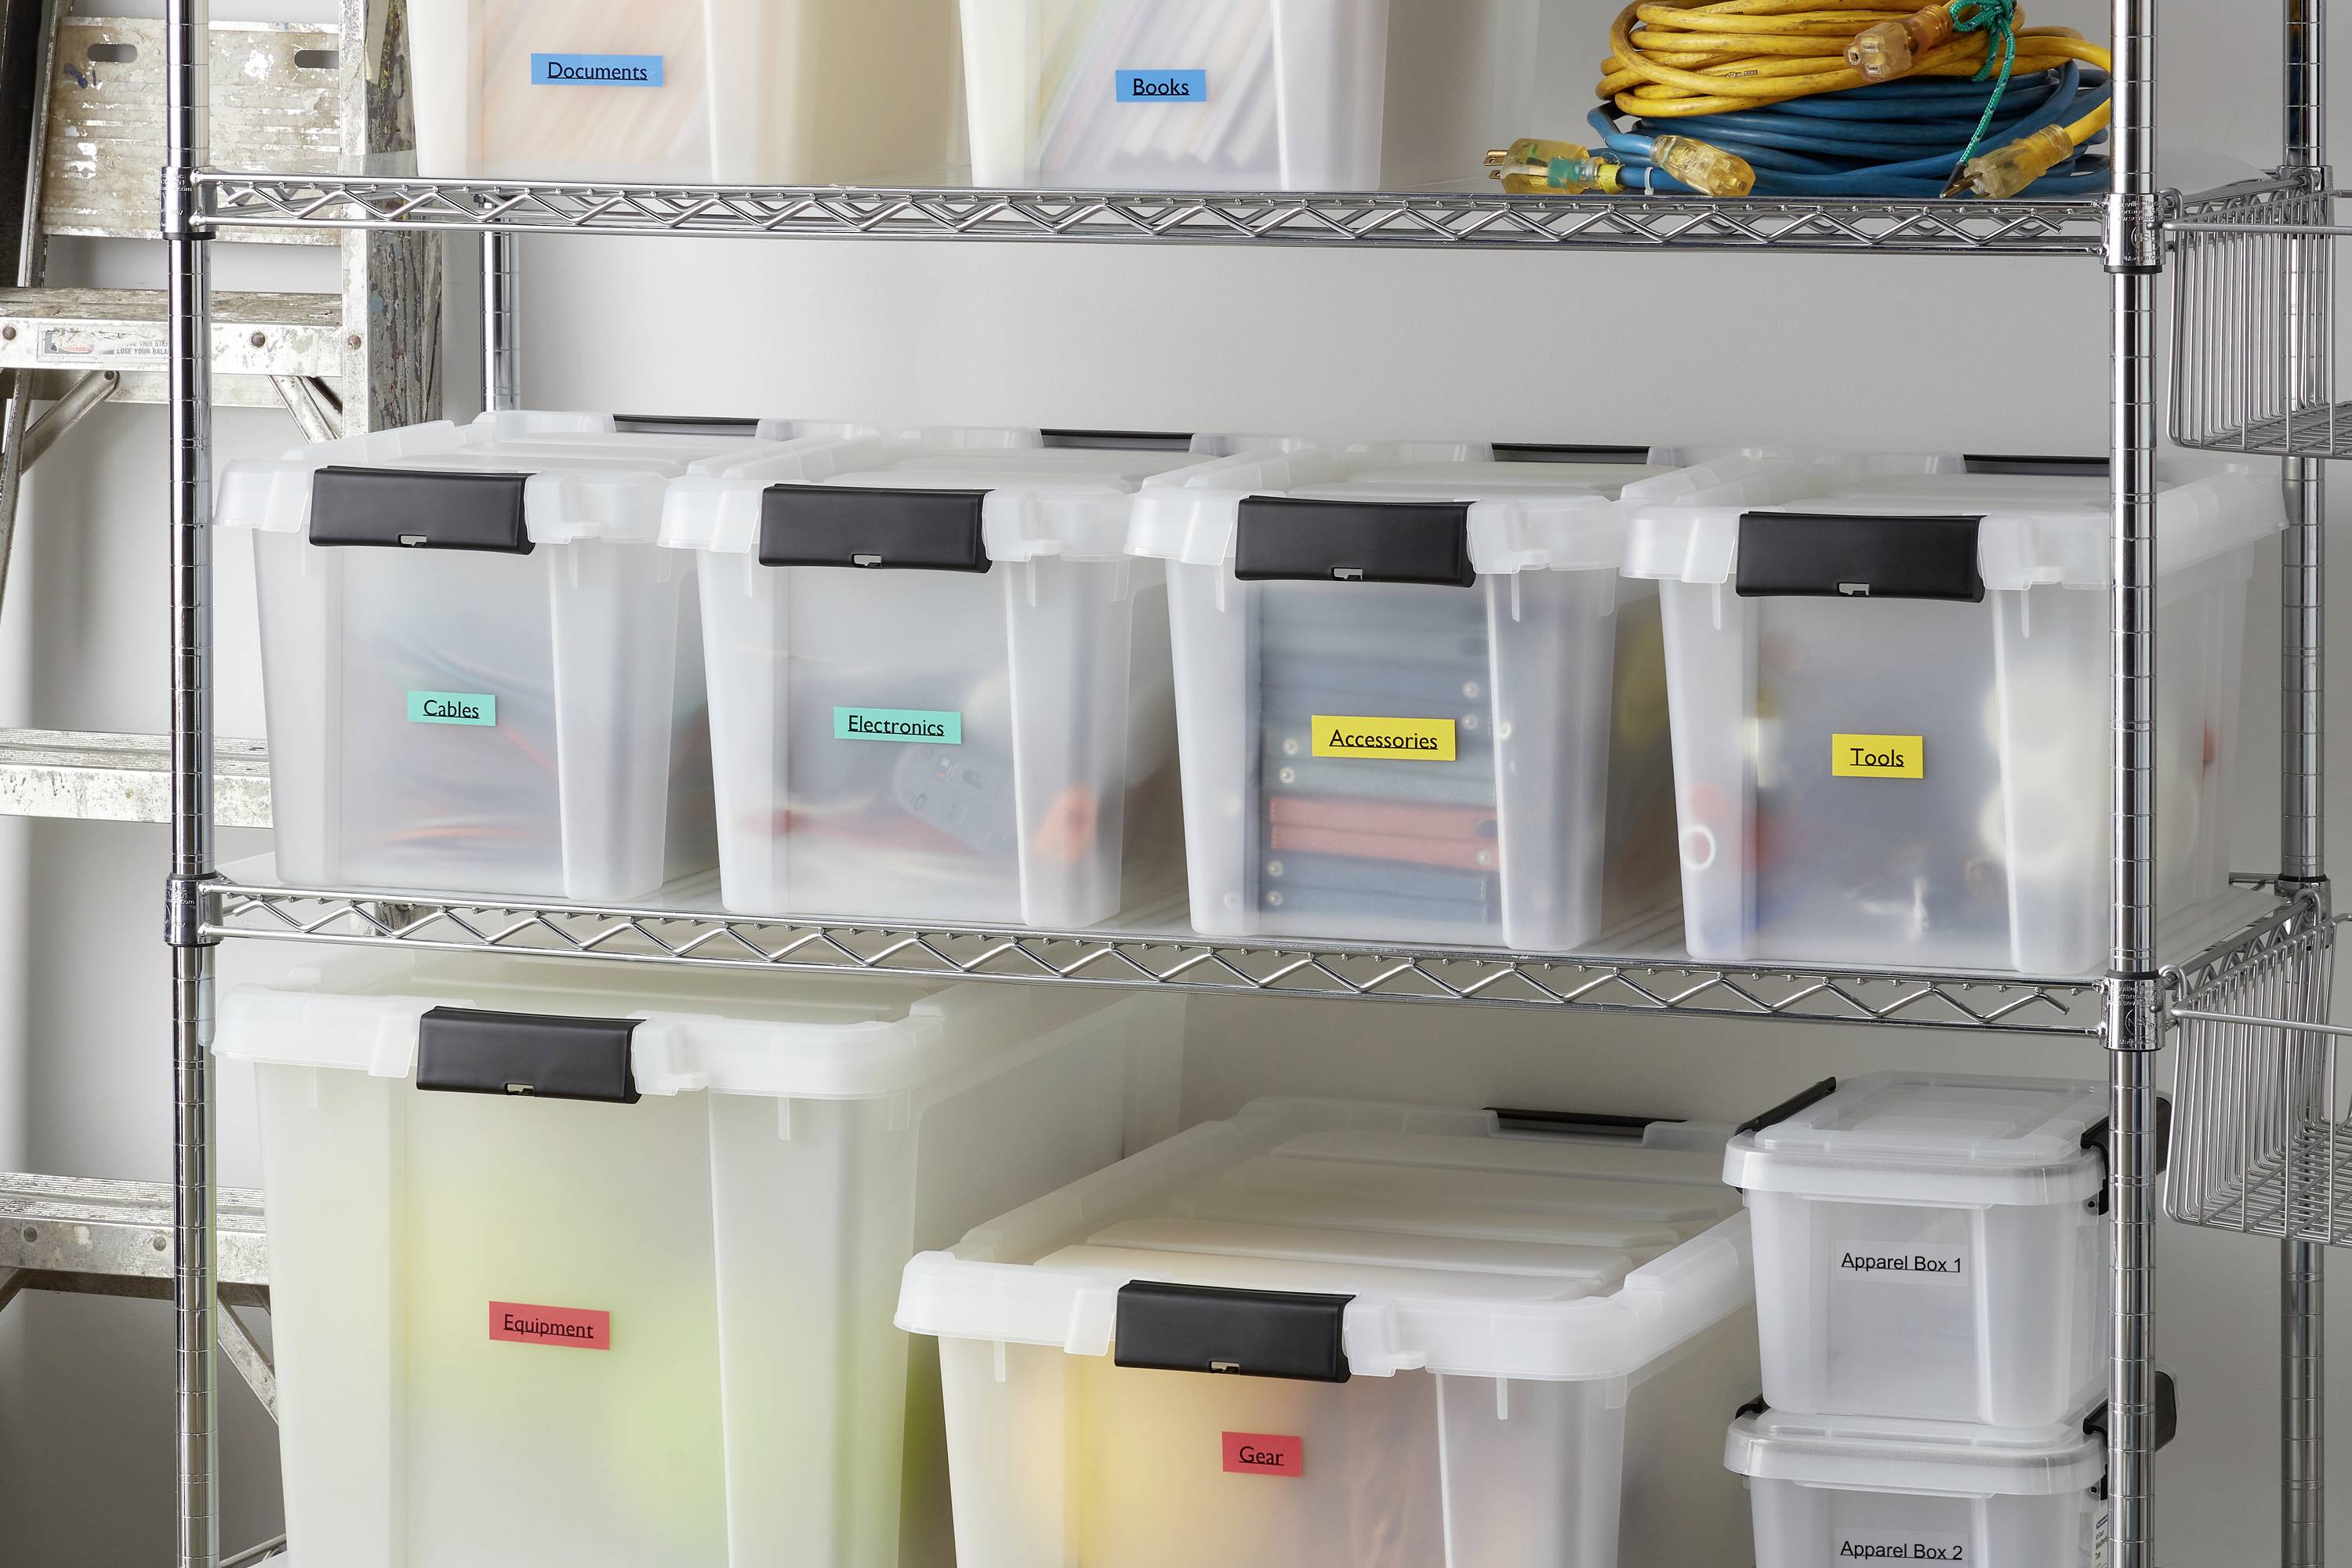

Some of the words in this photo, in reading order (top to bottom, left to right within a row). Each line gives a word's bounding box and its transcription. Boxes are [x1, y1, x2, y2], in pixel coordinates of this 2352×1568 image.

[546, 61, 648, 82] Documents
[1132, 78, 1190, 96] Books
[423, 699, 480, 720] Cables
[848, 714, 946, 737] Electronics
[1328, 728, 1439, 750] Accessories
[1849, 747, 1905, 768] Tools
[1841, 1252, 1907, 1272] Apparel
[1915, 1255, 1947, 1272] Box
[1954, 1258, 1961, 1273] 1
[503, 1313, 594, 1339] Equipment
[1238, 1446, 1285, 1467] Gear
[1840, 1541, 1907, 1560] Apparel
[1914, 1543, 1947, 1559] Box
[1952, 1545, 1963, 1560] 2
